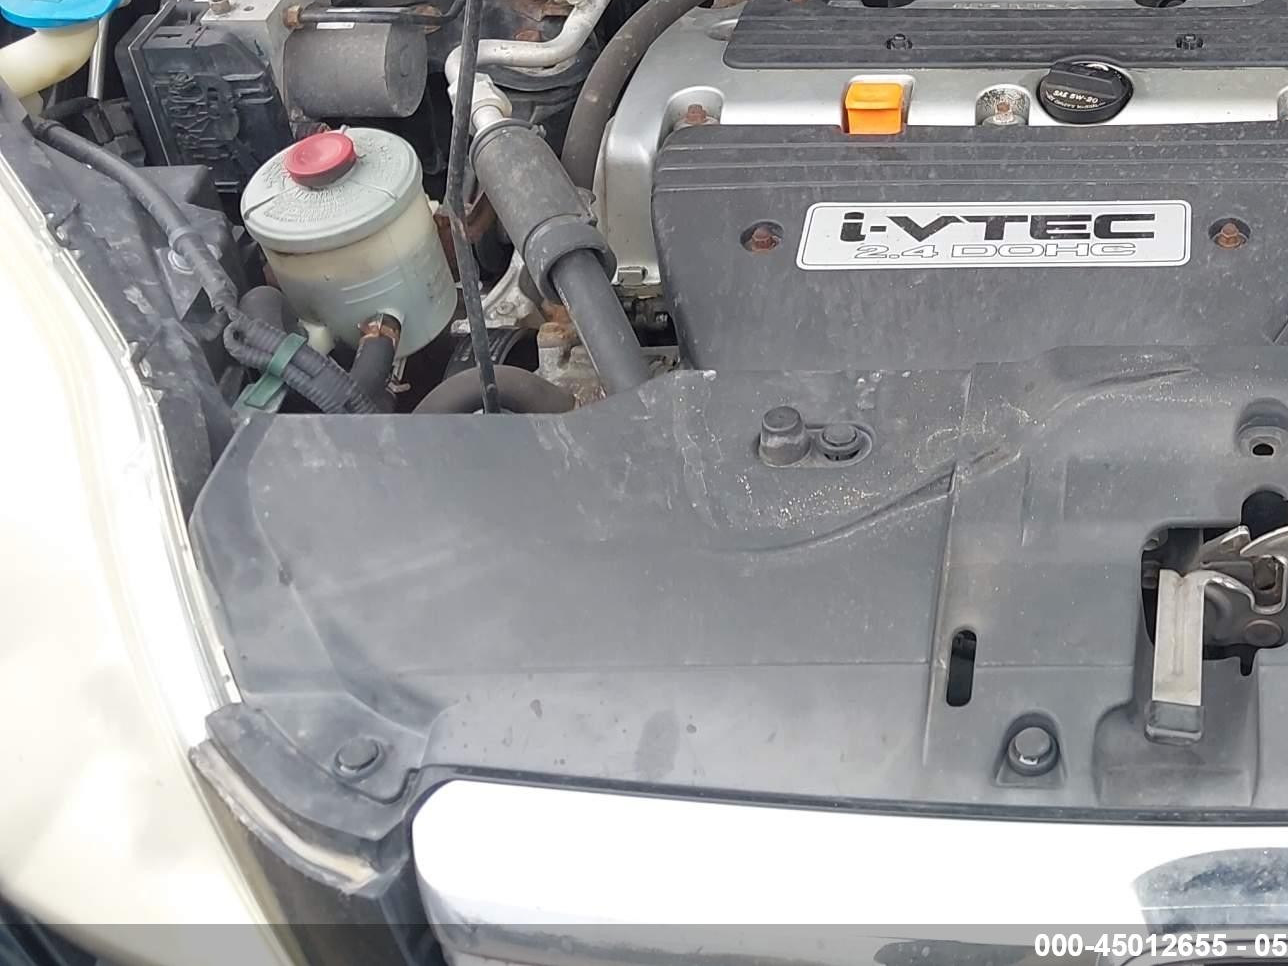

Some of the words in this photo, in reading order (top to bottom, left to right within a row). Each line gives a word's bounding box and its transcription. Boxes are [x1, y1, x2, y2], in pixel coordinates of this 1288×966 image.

[839, 211, 1156, 243] i-VTEC
[853, 243, 939, 259] 2.4
[951, 242, 1137, 259] DOHC
